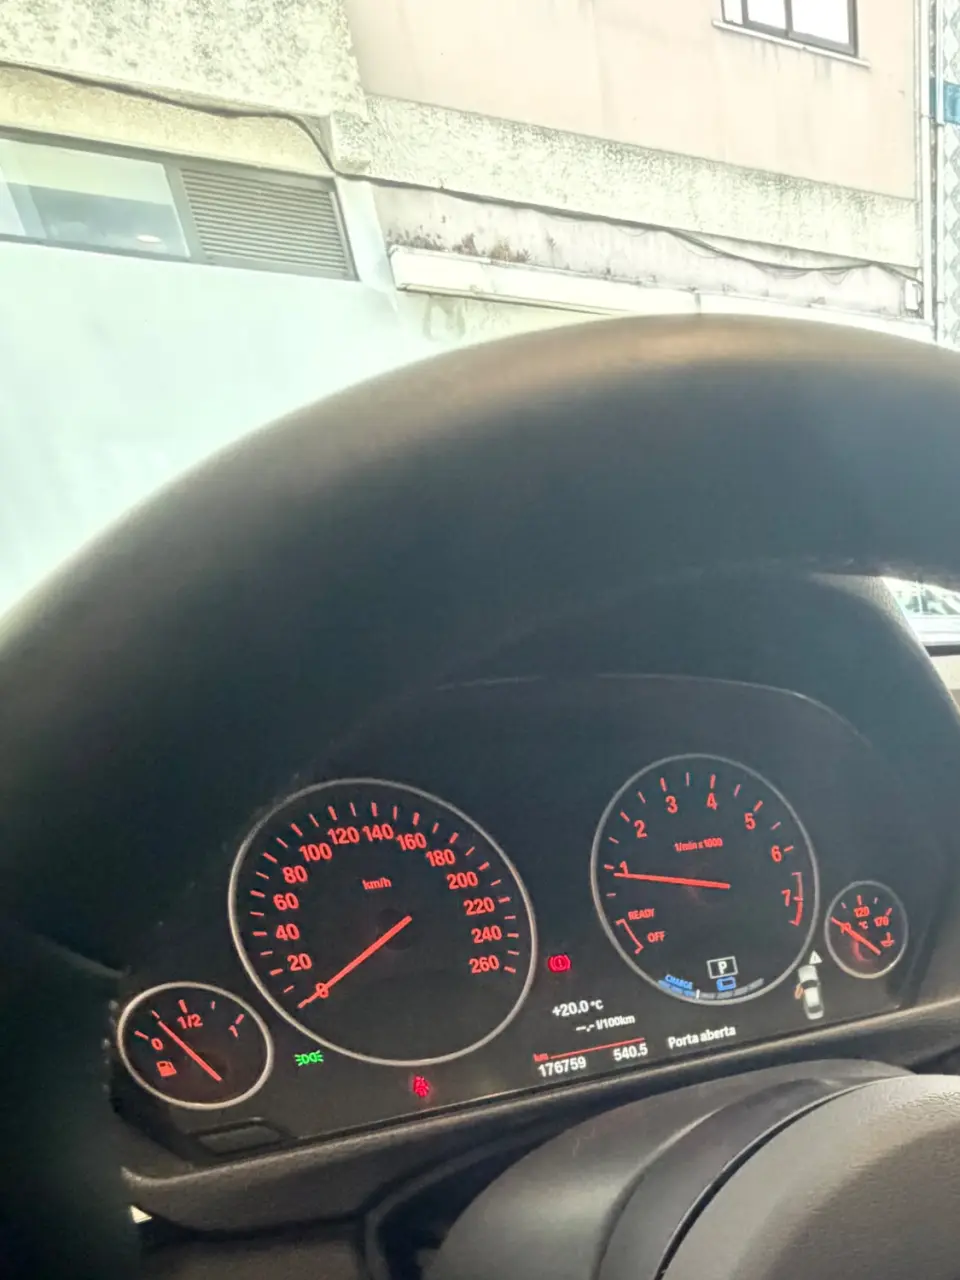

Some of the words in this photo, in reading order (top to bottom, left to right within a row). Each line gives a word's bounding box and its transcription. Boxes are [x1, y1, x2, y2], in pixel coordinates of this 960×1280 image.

[665, 795, 678, 814] 3
[707, 792, 718, 810] 4
[634, 819, 647, 838] 2
[744, 812, 756, 830] 5
[327, 826, 360, 845] 120
[362, 823, 395, 843] 140
[397, 832, 428, 851] 160
[299, 842, 333, 862] 100
[426, 849, 456, 868] 180
[771, 845, 782, 862] 6
[282, 865, 308, 884] 80
[362, 877, 392, 890] km/h
[446, 871, 479, 890] 200
[273, 892, 299, 911] 60
[463, 897, 495, 916] 220
[781, 890, 792, 907] 7
[627, 908, 655, 920] READY
[275, 923, 300, 941] 40
[471, 926, 502, 944] 240
[647, 931, 665, 943] OFF
[287, 953, 312, 972] 20
[469, 955, 500, 974] 260
[717, 961, 728, 975] P
[664, 974, 693, 990] CHARGE
[552, 1000, 589, 1018] +20.0
[590, 999, 604, 1011] °C
[177, 1013, 203, 1029] 1/2
[228, 1024, 239, 1038] 1
[667, 1033, 699, 1049] Porta
[700, 1025, 736, 1042] aberta
[150, 1037, 164, 1051] 0
[613, 1043, 648, 1062] 540.5
[538, 1056, 587, 1077] 176759
